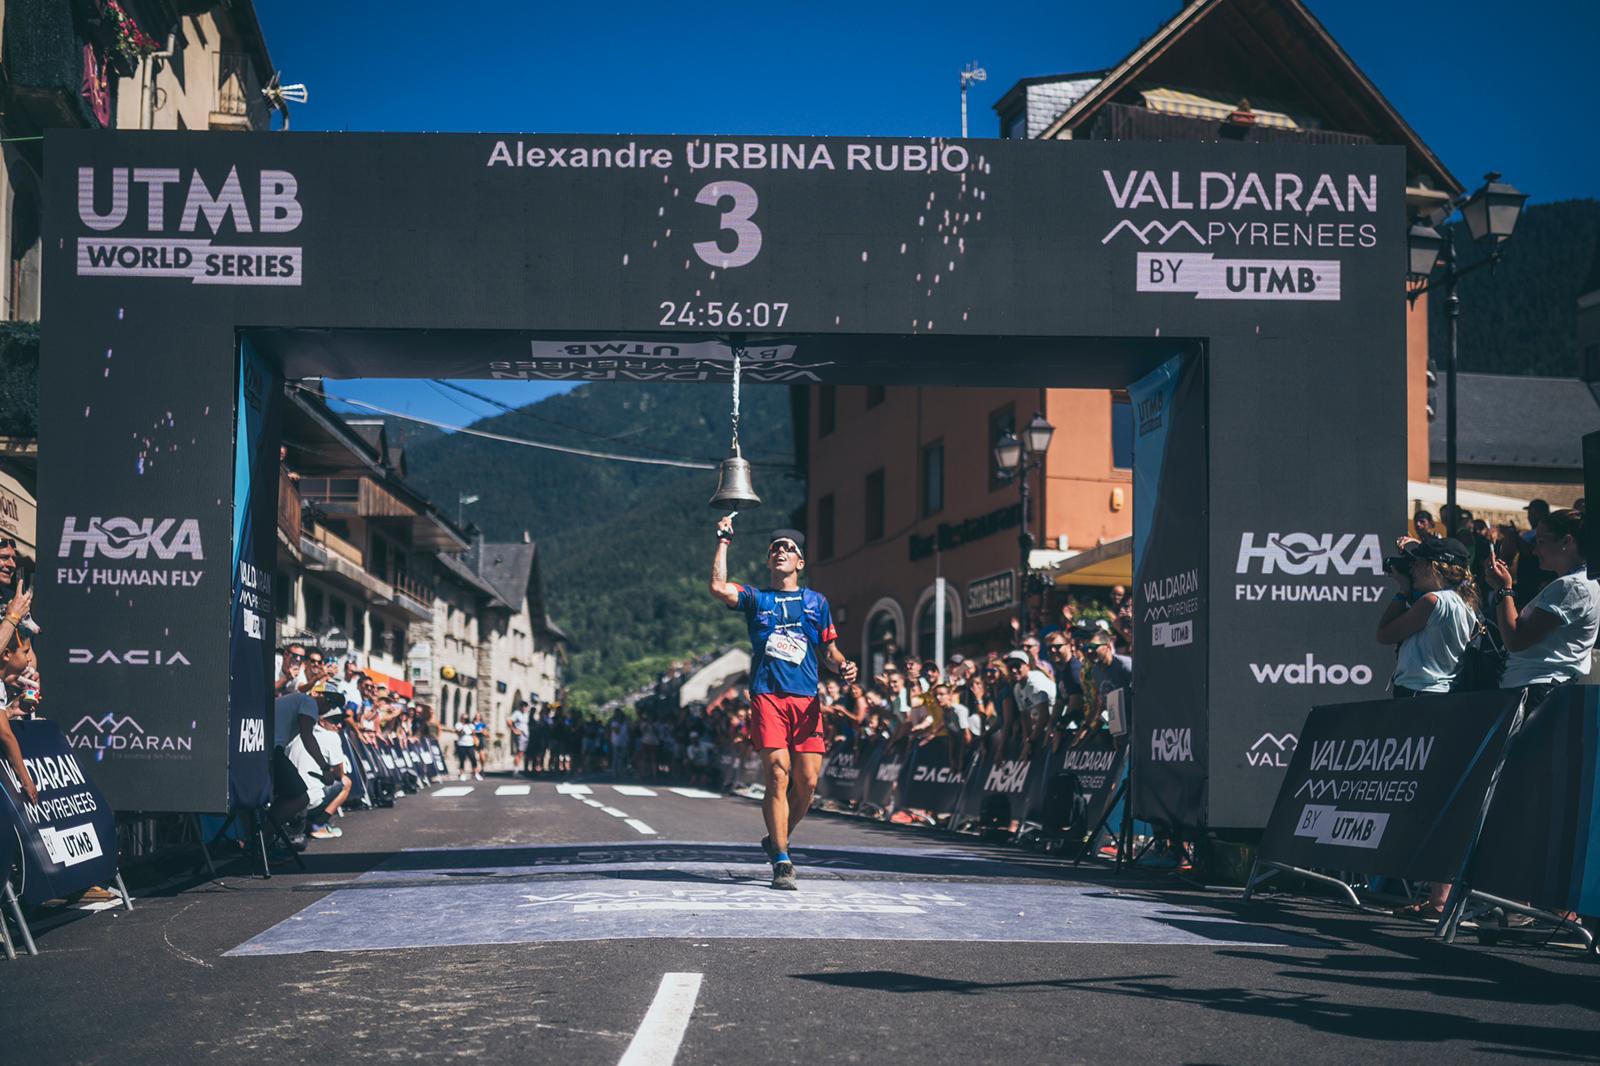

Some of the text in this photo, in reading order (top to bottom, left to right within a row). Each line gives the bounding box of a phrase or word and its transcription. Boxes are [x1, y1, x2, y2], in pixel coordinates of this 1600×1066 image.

[487, 141, 969, 172] Alexandre URBINA RUBIO
[78, 164, 303, 235] UTMB
[693, 180, 763, 268] 3
[1208, 222, 1376, 247] PYRENEES
[87, 245, 294, 278] WORLD SERIES
[1150, 259, 1317, 294] BY UTMB
[659, 301, 789, 328] 24:56:07
[489, 360, 701, 371] PYRENEES
[58, 516, 203, 560] HOKA
[1236, 532, 1384, 576] HOKA
[57, 568, 203, 586] FLY HUMAN FLY
[1235, 584, 1384, 602] FLY HUMAN FLY
[1155, 625, 1190, 643] BY UTMB
[69, 649, 191, 665] DACIA
[1249, 653, 1373, 685] wahoo
[239, 719, 264, 752] HOKA
[1151, 728, 1193, 761] HOKA
[984, 760, 1031, 793] HOKA
[1337, 780, 1418, 802] PYRENEES
[42, 791, 97, 820] PYRENEES
[1302, 810, 1374, 842] BY UTMB
[63, 831, 94, 858] UTMB
